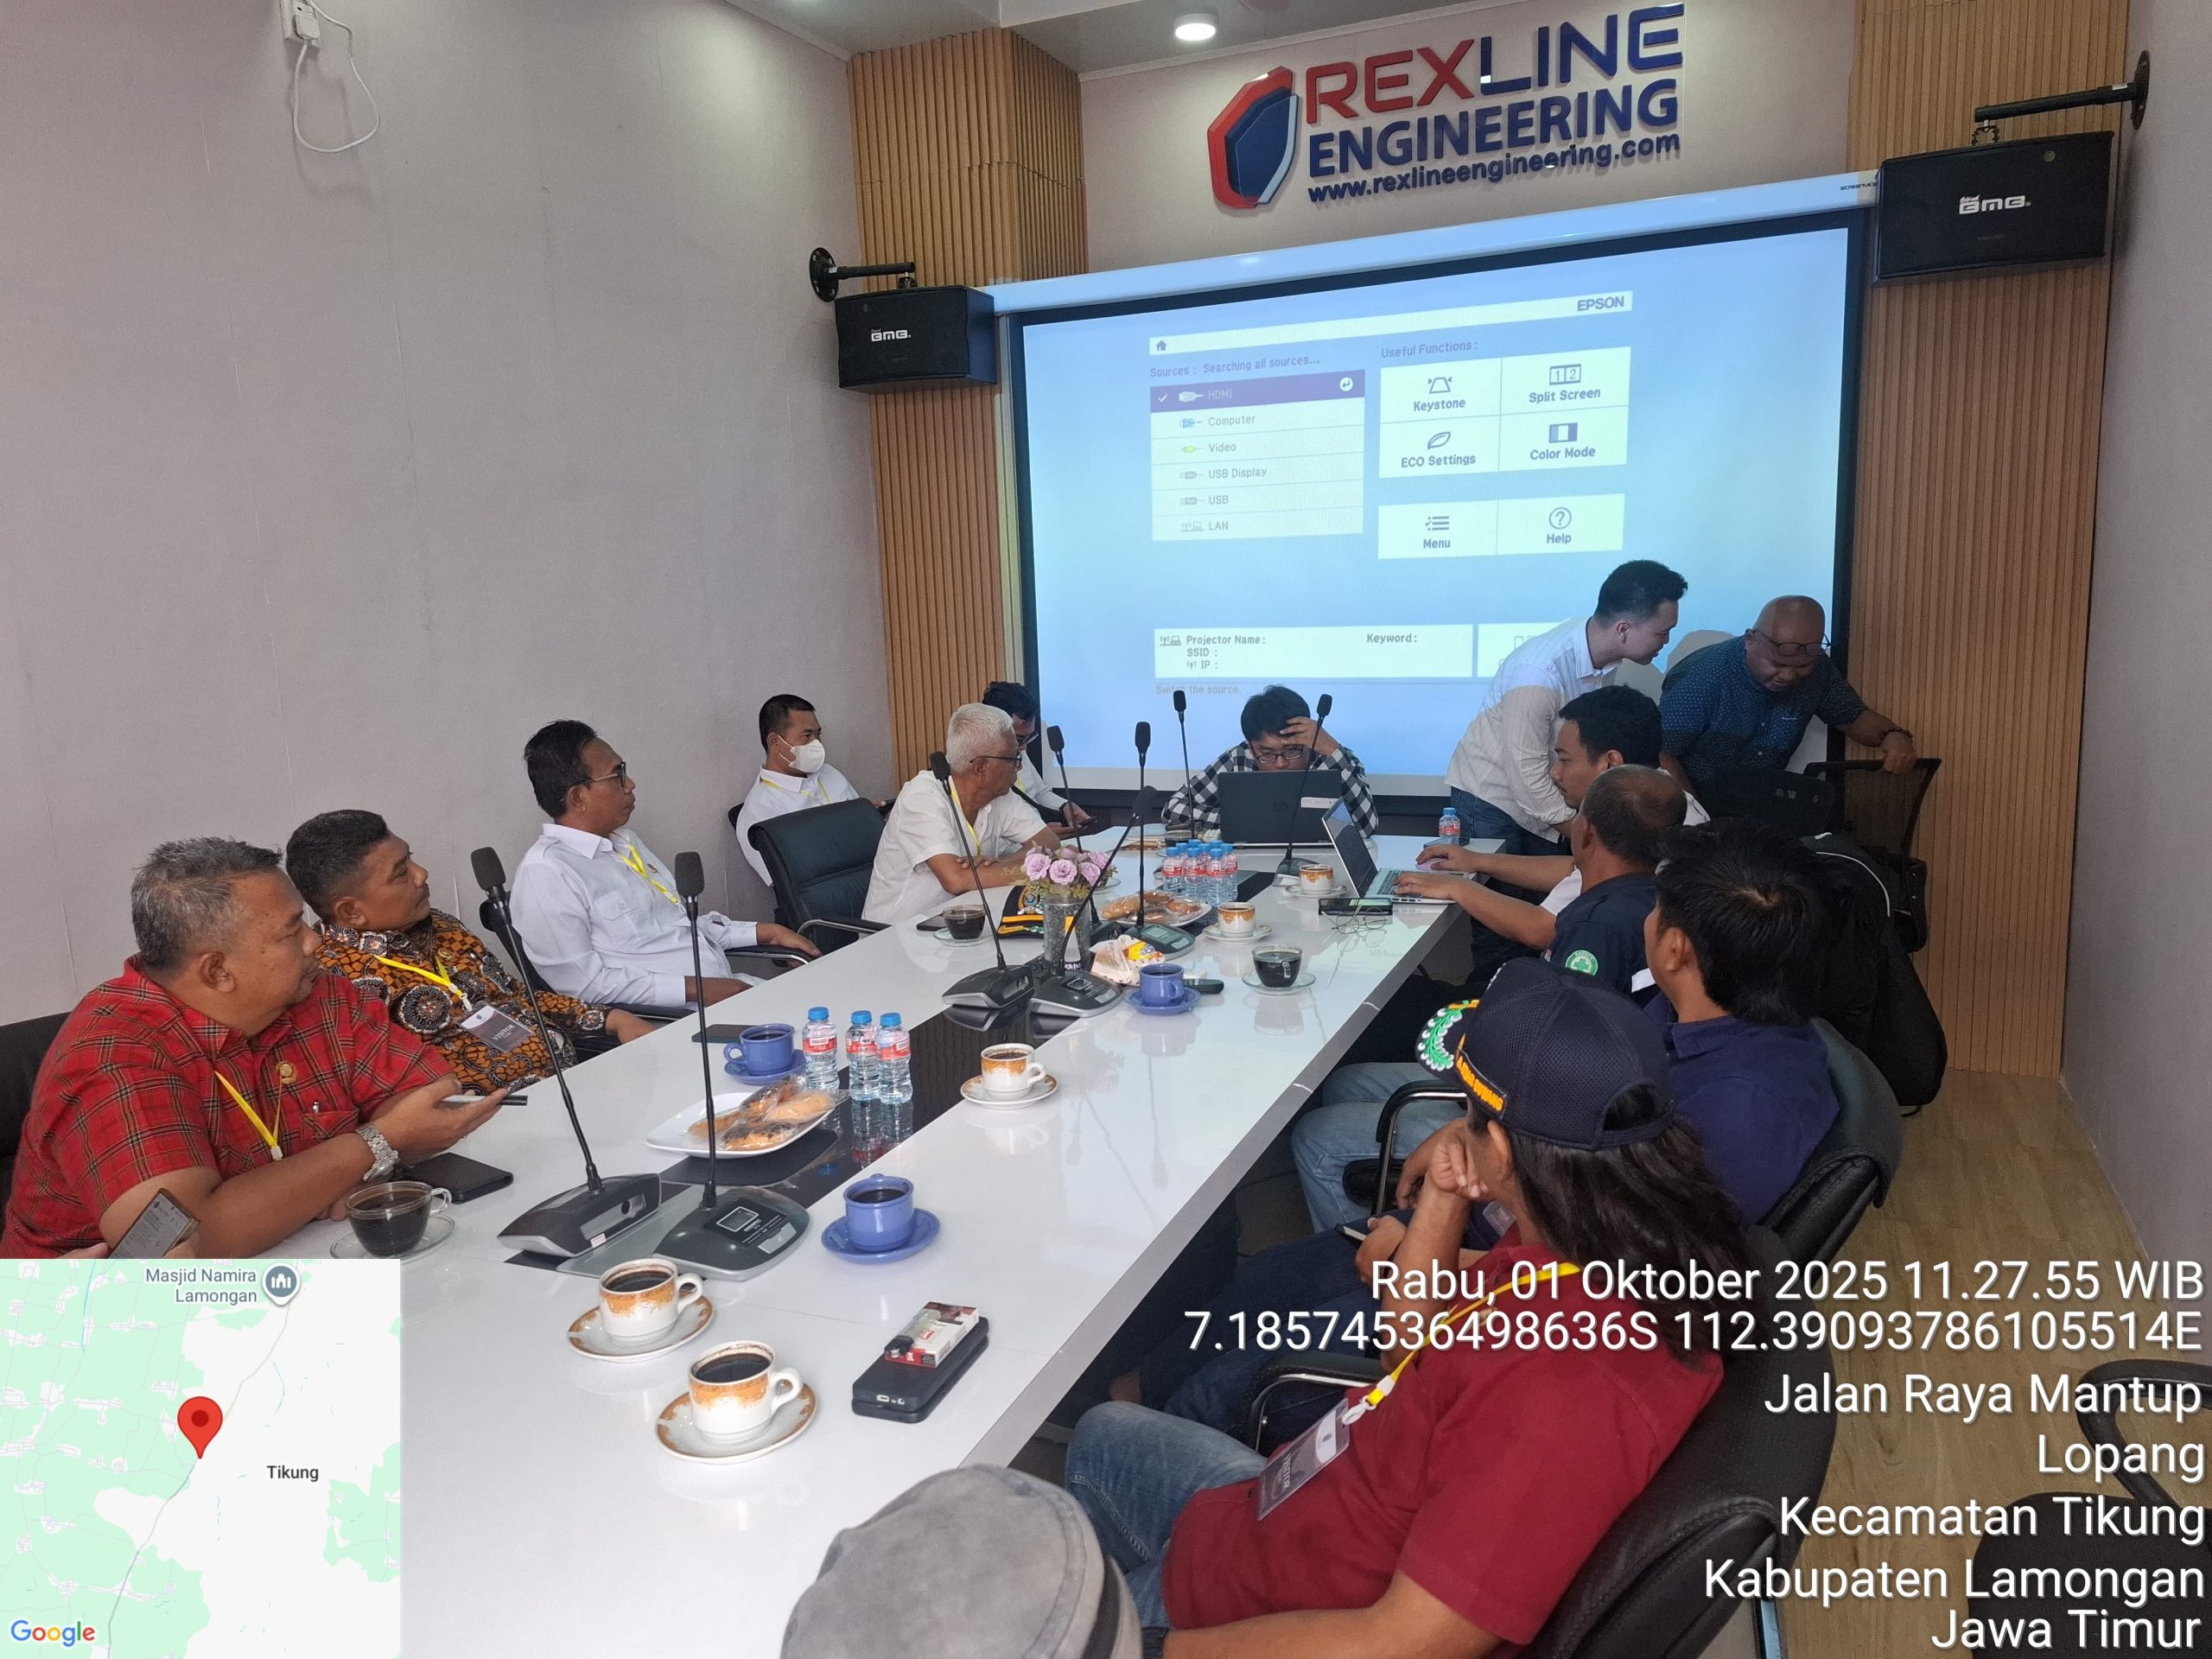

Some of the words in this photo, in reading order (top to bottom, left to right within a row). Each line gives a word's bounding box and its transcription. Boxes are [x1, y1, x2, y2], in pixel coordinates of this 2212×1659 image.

[1306, 3, 1684, 124] REXLINE
[1309, 78, 1678, 178] ENGINEERING
[1307, 132, 1680, 202] www.rexlineengineering.com
[1578, 296, 1624, 311] EPSON
[1381, 346, 1415, 358] Useful
[1150, 367, 1189, 378] Sources
[1203, 361, 1251, 373] Searching
[1255, 359, 1266, 369] all
[1269, 357, 1319, 367] sources...
[1208, 389, 1232, 399] HDMI
[1529, 391, 1555, 404] Split
[1560, 389, 1600, 400] Screen
[1414, 399, 1465, 411] Keystone
[1208, 416, 1255, 426] Computer
[1209, 443, 1236, 453] Video
[1530, 449, 1560, 460] Color
[1565, 447, 1595, 458] Mode
[1402, 456, 1424, 467] ECO
[1428, 454, 1476, 466] Settings
[1209, 469, 1228, 479] USB
[1231, 467, 1267, 478] Display
[1209, 495, 1229, 505] USB
[1209, 521, 1229, 530] LAN
[1423, 538, 1450, 549] Menu
[1547, 534, 1572, 544] Help
[1186, 635, 1231, 645] Projector
[1186, 648, 1210, 657] SSID
[1201, 660, 1210, 670] IP
[1189, 685, 1204, 694] the
[492, 1024, 516, 1041] VISITOR
